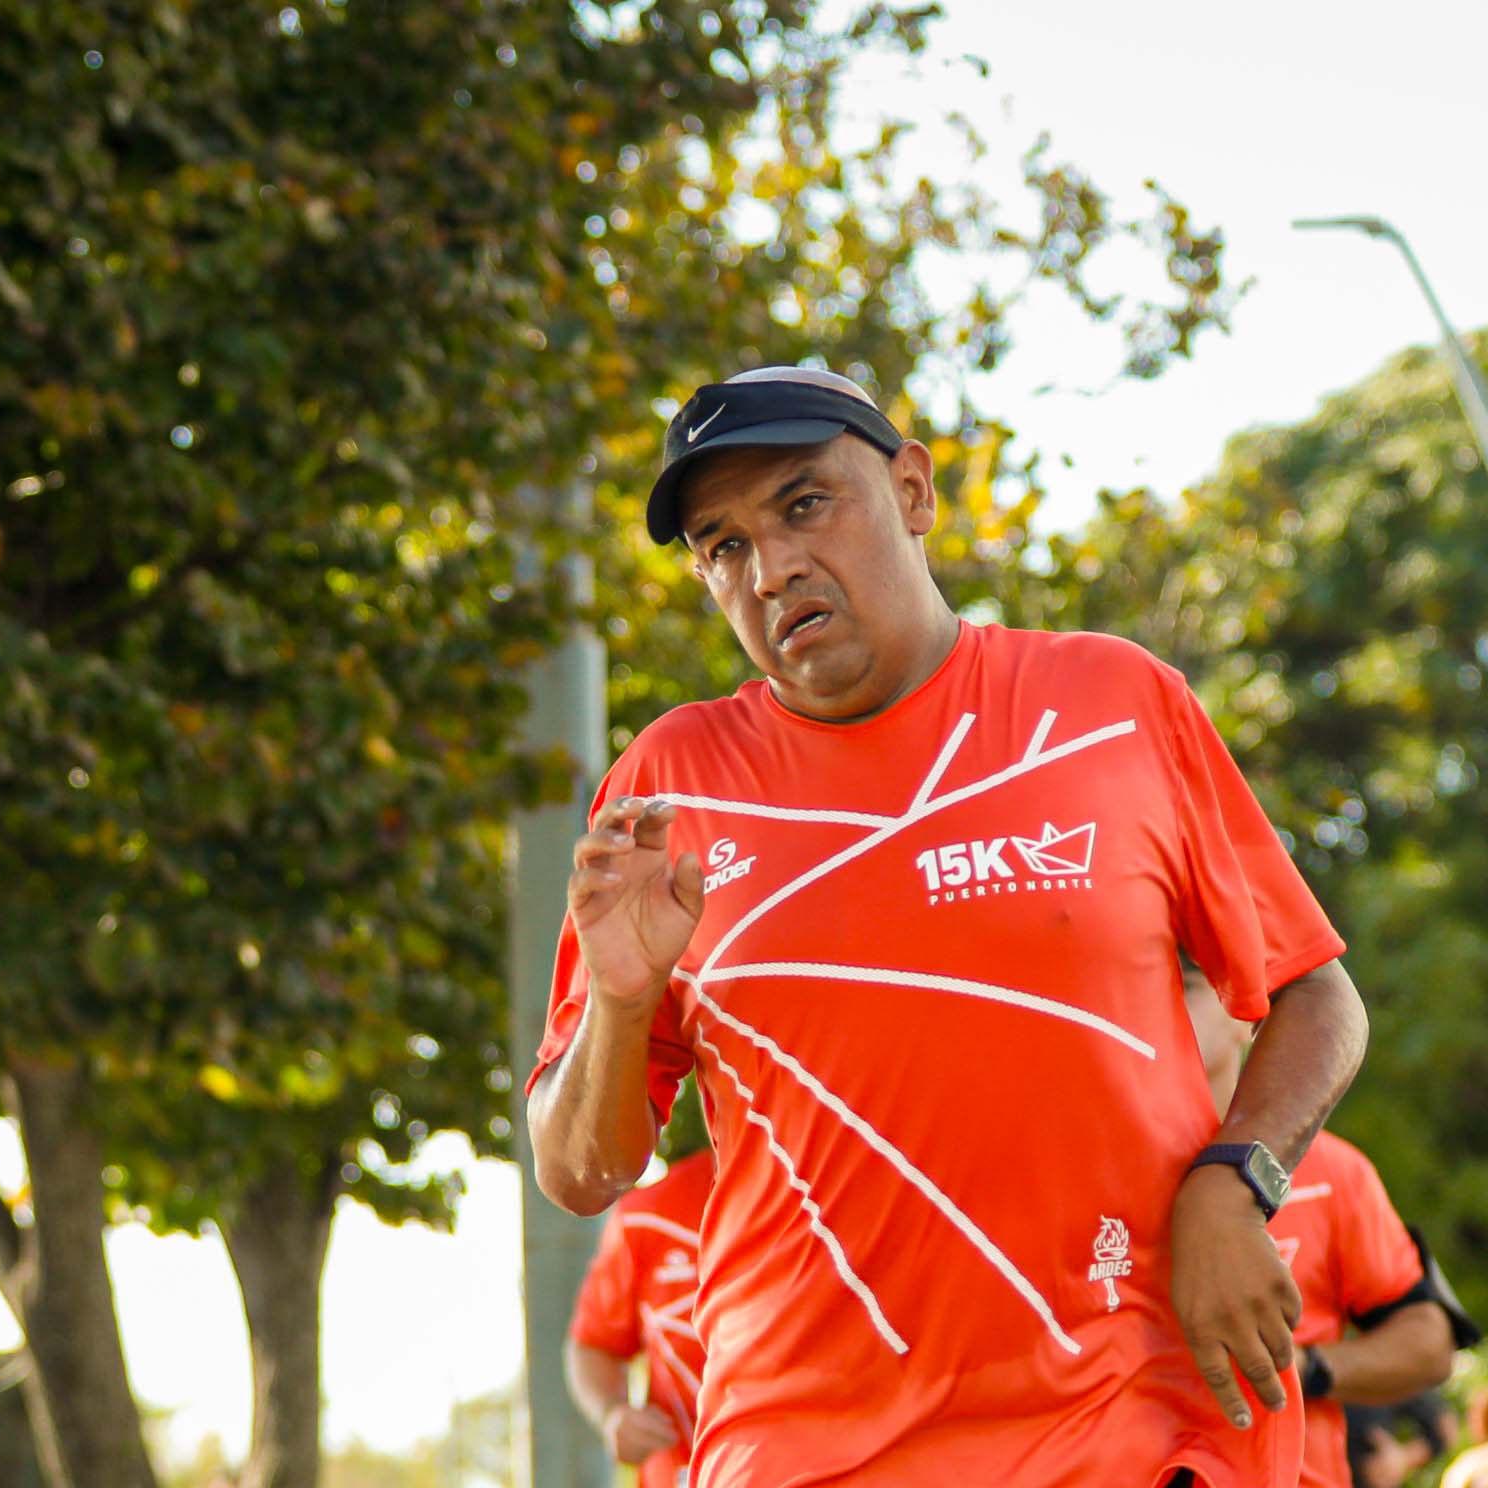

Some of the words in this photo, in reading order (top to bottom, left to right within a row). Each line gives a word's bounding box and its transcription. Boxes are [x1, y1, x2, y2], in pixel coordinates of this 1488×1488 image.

[916, 838, 1015, 891] 15K
[929, 883, 1018, 906] PUERTO
[1026, 879, 1094, 892] NORTE
[1088, 1260, 1133, 1281] ARDEC
